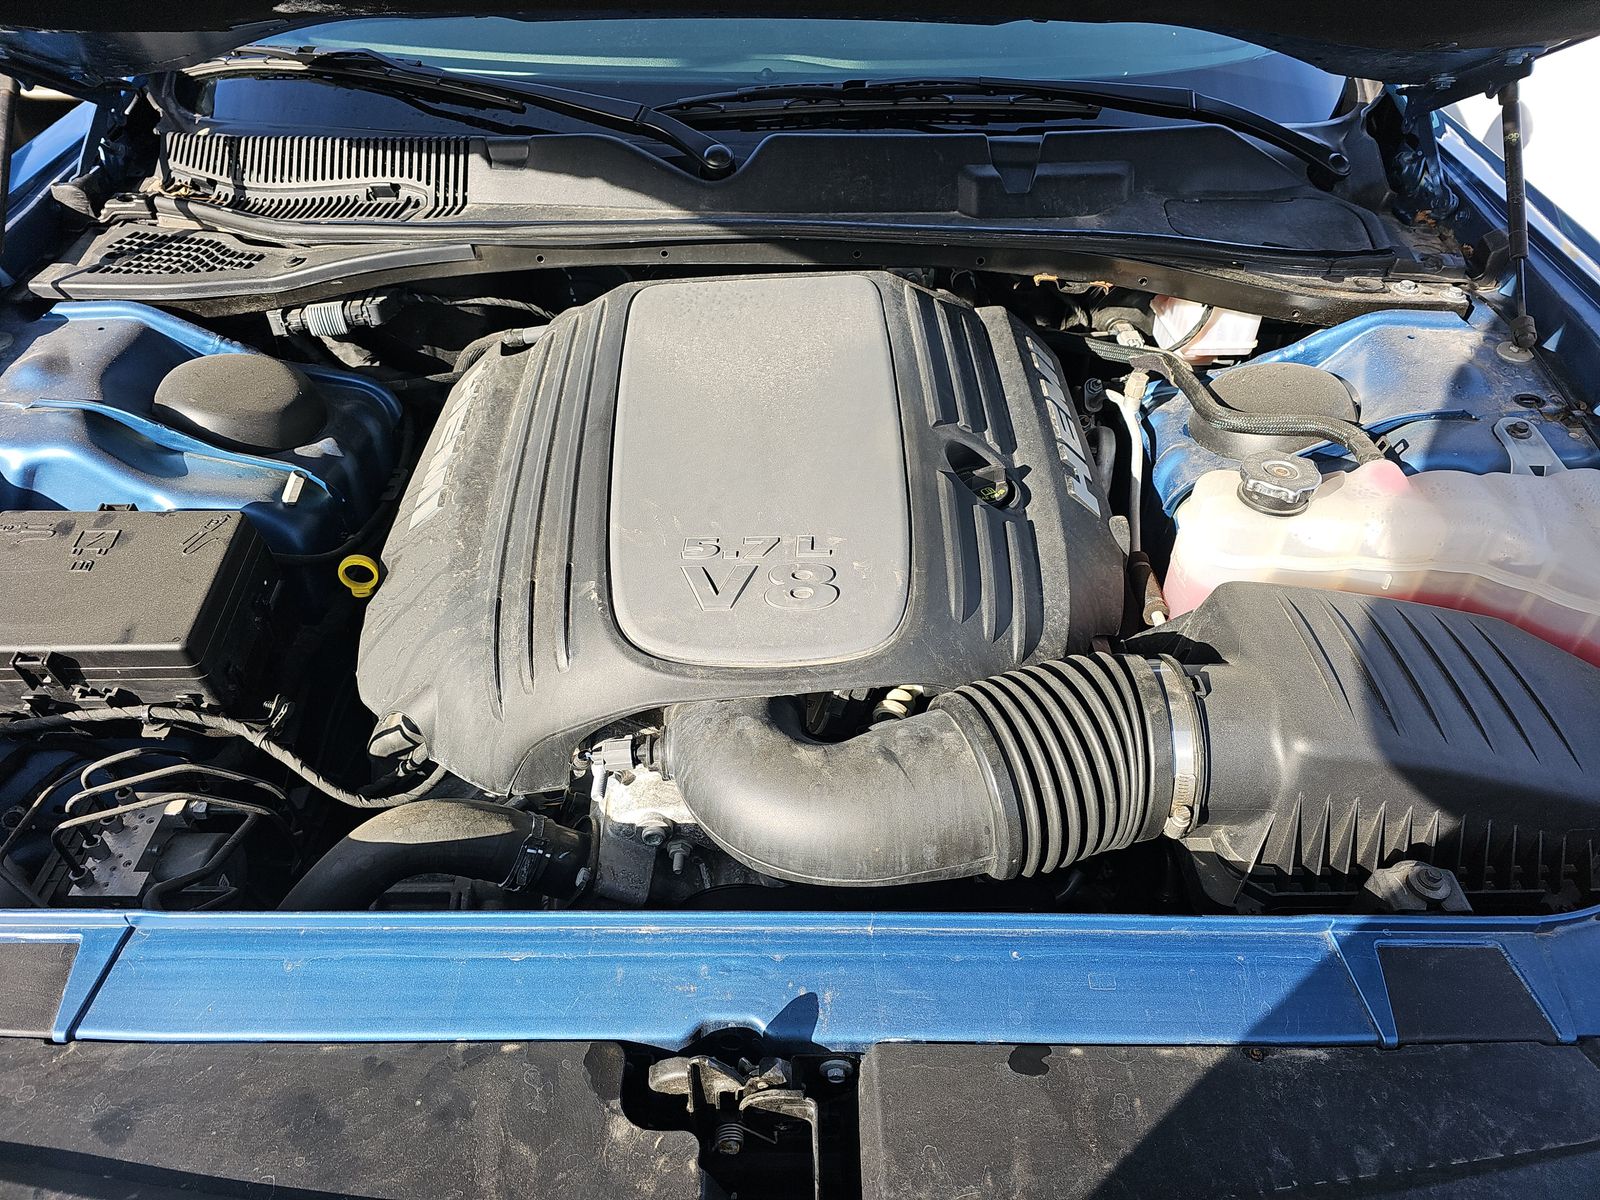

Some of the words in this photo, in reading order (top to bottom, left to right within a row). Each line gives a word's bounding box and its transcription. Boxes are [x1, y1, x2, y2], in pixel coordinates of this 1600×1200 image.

[409, 360, 489, 532] HEMI
[1026, 336, 1101, 517] HEMI
[680, 562, 841, 611] V8
